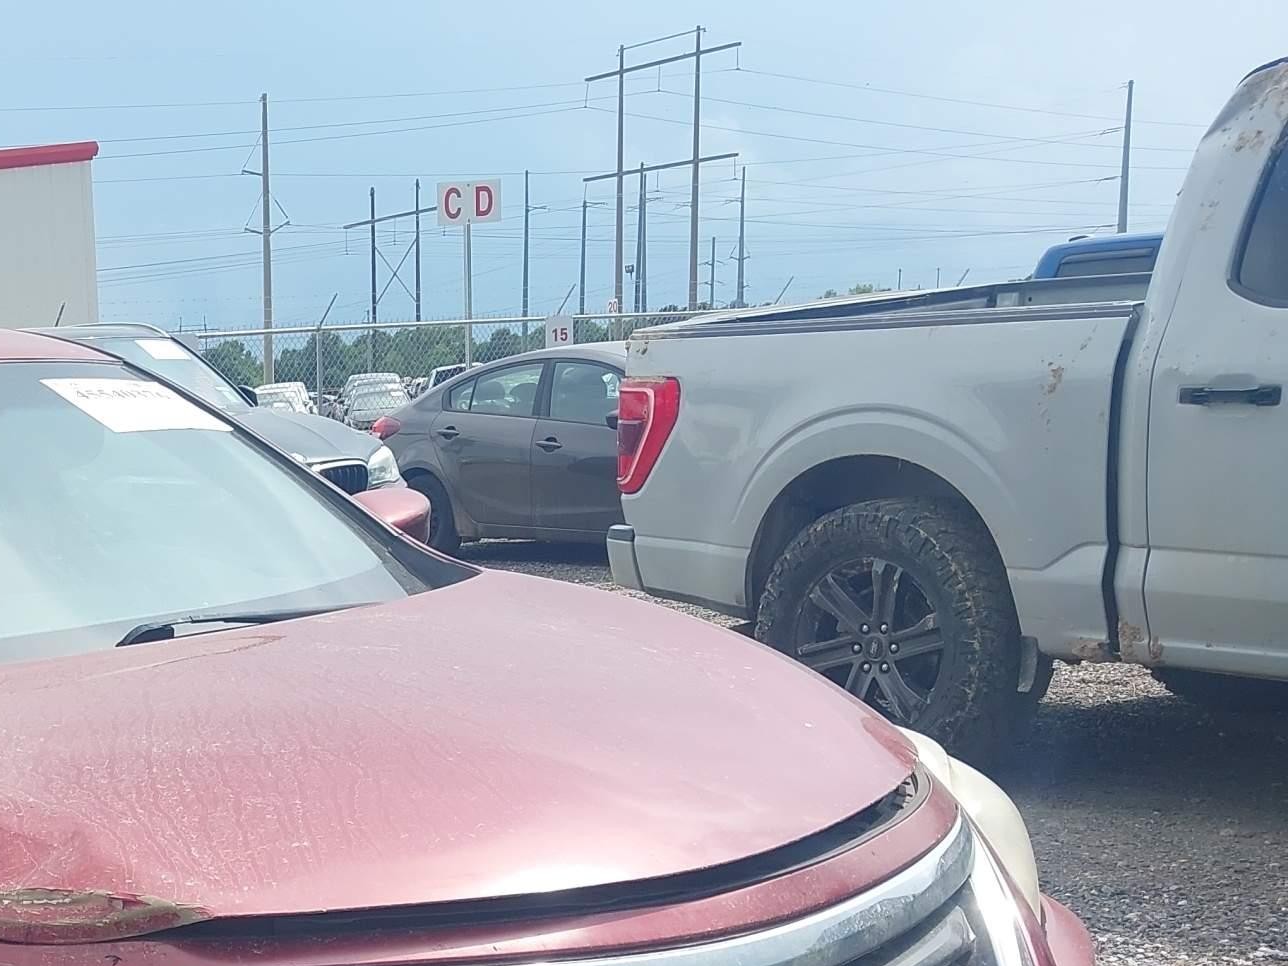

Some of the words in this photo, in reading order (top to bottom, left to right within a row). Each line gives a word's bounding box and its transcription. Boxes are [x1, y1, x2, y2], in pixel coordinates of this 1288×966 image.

[444, 187, 462, 219] C
[475, 185, 493, 217] D
[608, 300, 618, 313] 20
[552, 327, 568, 342] 15
